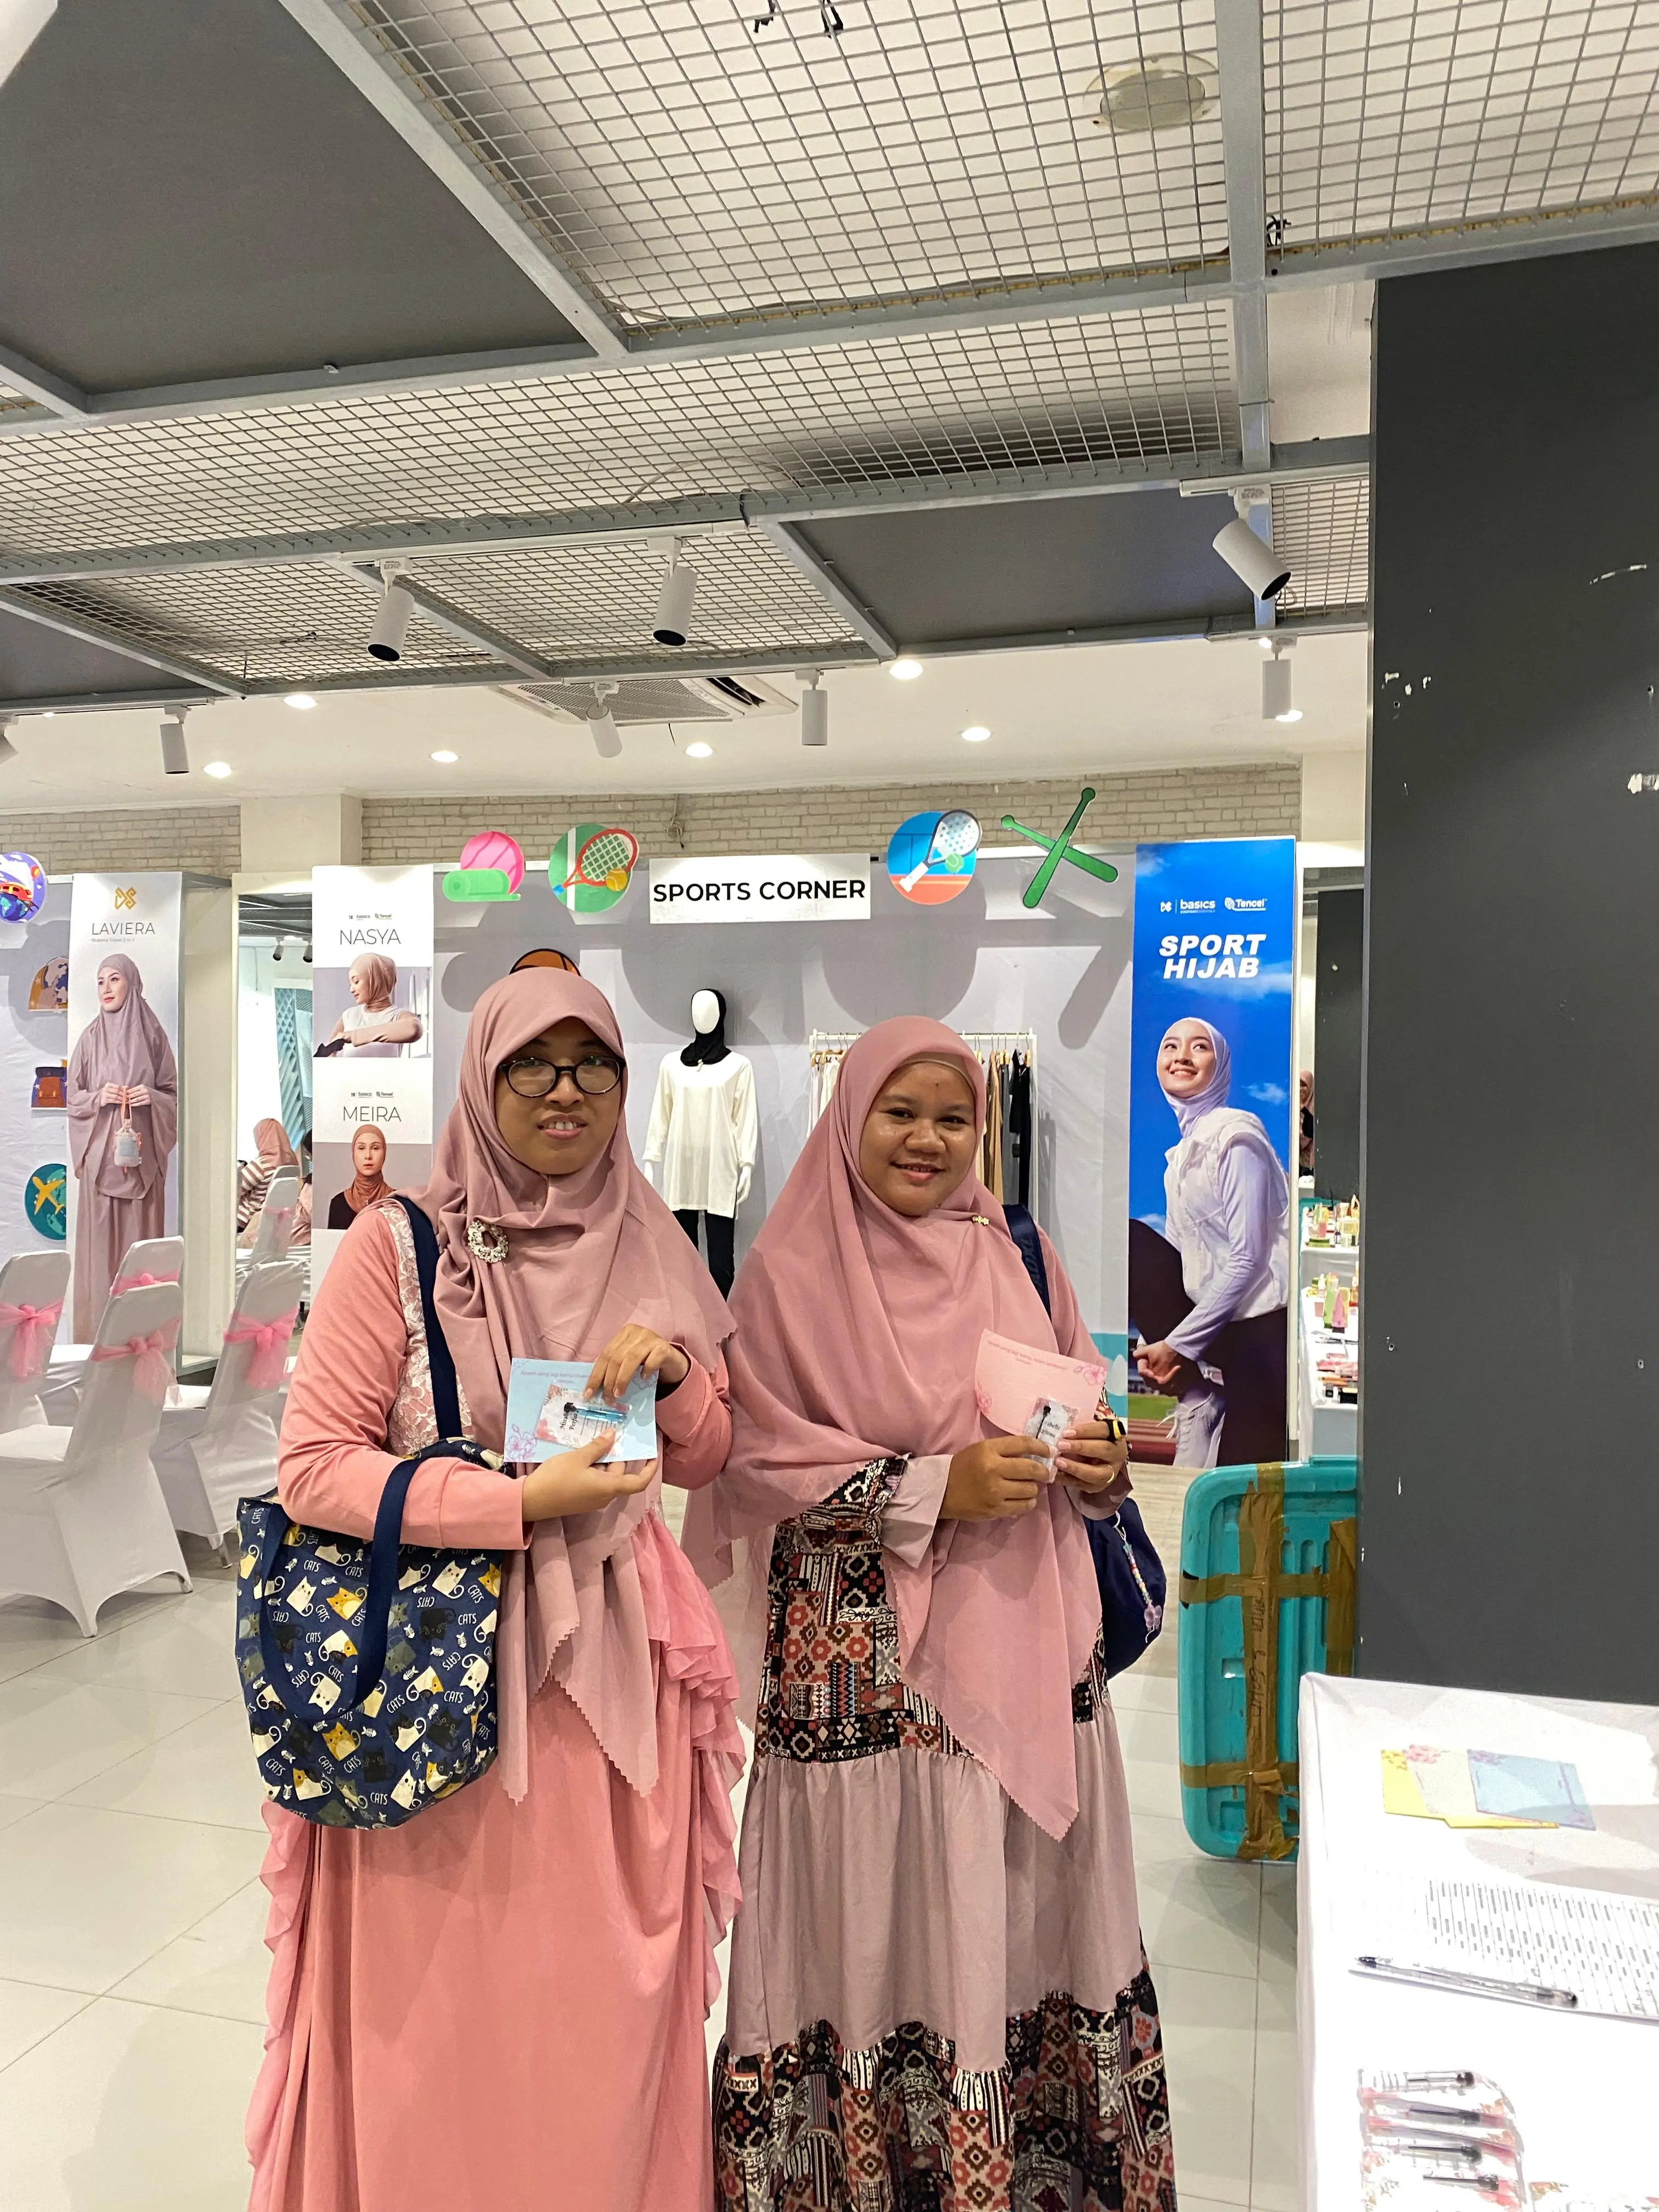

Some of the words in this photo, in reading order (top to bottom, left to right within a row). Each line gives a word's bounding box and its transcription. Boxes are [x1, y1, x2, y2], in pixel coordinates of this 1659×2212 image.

[653, 882, 751, 902] SPORTS
[759, 879, 866, 900] CORNER
[1180, 899, 1216, 910] basics
[1235, 898, 1265, 908] Tencel
[92, 922, 155, 935] LAVIERA
[340, 928, 401, 945] NASYA
[1159, 934, 1267, 957] SPORT
[1163, 957, 1259, 979] HIJAB
[343, 1106, 402, 1122] MEIRA
[251, 1507, 265, 1525] CATS
[303, 1560, 321, 1573] CATS
[345, 1566, 364, 1578] CATS
[416, 1596, 435, 1608] CATS
[467, 1584, 484, 1604] CATS
[272, 1611, 290, 1623] CATS
[315, 1604, 330, 1623] CATS
[458, 1613, 477, 1626] CATS
[306, 1632, 321, 1644] CATS
[442, 1651, 461, 1672] CATS
[291, 1669, 310, 1689] CATS
[328, 1664, 345, 1683] CATS
[386, 1694, 406, 1714] CATS
[444, 1690, 464, 1704] CATS
[265, 1758, 286, 1777] CATS
[318, 1755, 335, 1775] CATS
[343, 1755, 362, 1774] CATS
[370, 1792, 388, 1805] CATS
